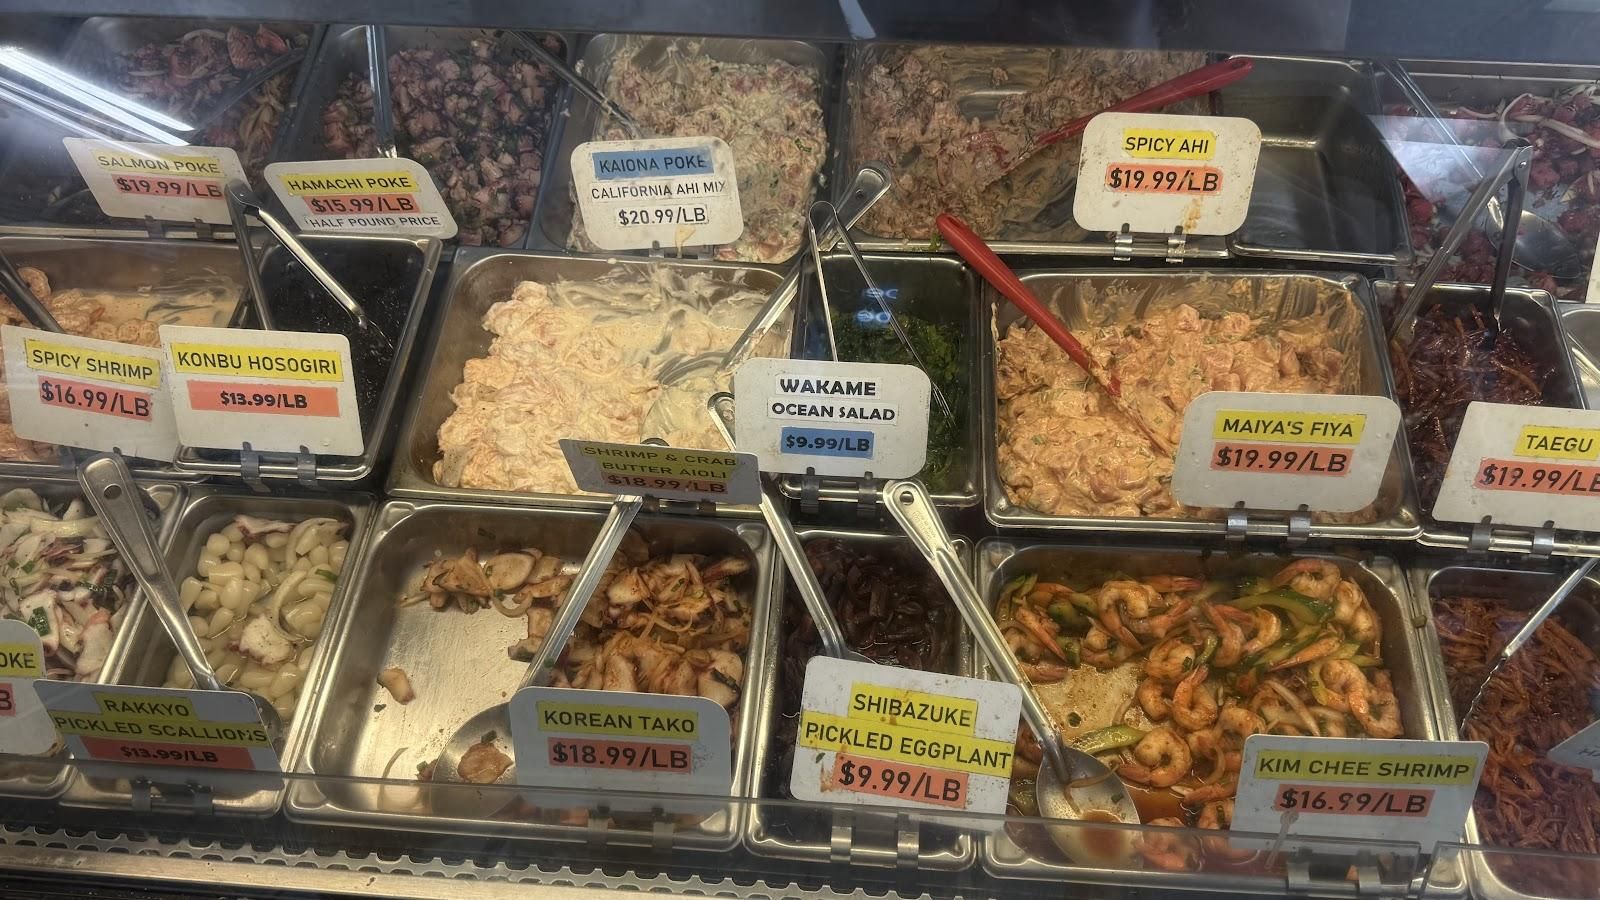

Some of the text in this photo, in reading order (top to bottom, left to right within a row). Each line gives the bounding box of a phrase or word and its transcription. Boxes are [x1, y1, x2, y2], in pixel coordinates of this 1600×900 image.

[1125, 136, 1209, 154] SPICY AHI
[98, 156, 220, 174] SALMON POKE
[599, 155, 708, 173] KAIONA POKE
[116, 177, 223, 198] $19.99/LB
[287, 177, 412, 191] HAMACHI POKE
[1109, 167, 1219, 191] $19.99/LB
[591, 180, 726, 199] CALIFORNIA AHI MIX
[311, 196, 414, 213] $15.99/LB
[310, 216, 441, 228] HALF POUND PRICE
[618, 206, 707, 226] $20.99/LB
[32, 349, 153, 381] SPICY SHRIMP
[177, 351, 337, 374] KONBU HOSOGIRI
[779, 378, 876, 396] WAKAME
[41, 380, 150, 417] $16.99/LB
[220, 390, 308, 409] $13.99/LB
[771, 402, 896, 421] OCEAN SALAD
[1222, 418, 1353, 438] MAIYA'S FIYA
[785, 434, 870, 452] $9.99/LB
[1526, 434, 1593, 453] TAEGU
[583, 446, 737, 466] SHRIMP & CRAB
[1217, 445, 1347, 473] $19.99/LB
[601, 462, 727, 479] BUTTER AIOLI
[607, 474, 725, 493] $18.99/LB
[103, 699, 190, 717] RAKKYO
[853, 693, 973, 728] SHIBAZUKE
[54, 716, 267, 742] PICKLED SCALLIONS
[544, 710, 695, 733] KOREAN TAKO
[120, 746, 218, 763] $13.99/LB
[552, 741, 688, 769] $18.99/LB
[805, 721, 1012, 770] PICKLED EGGPLANT
[1258, 757, 1470, 779] KIM CHEE SHRIMP
[838, 760, 961, 802] $9.99/LB
[1279, 787, 1427, 813] $16.99/LB
